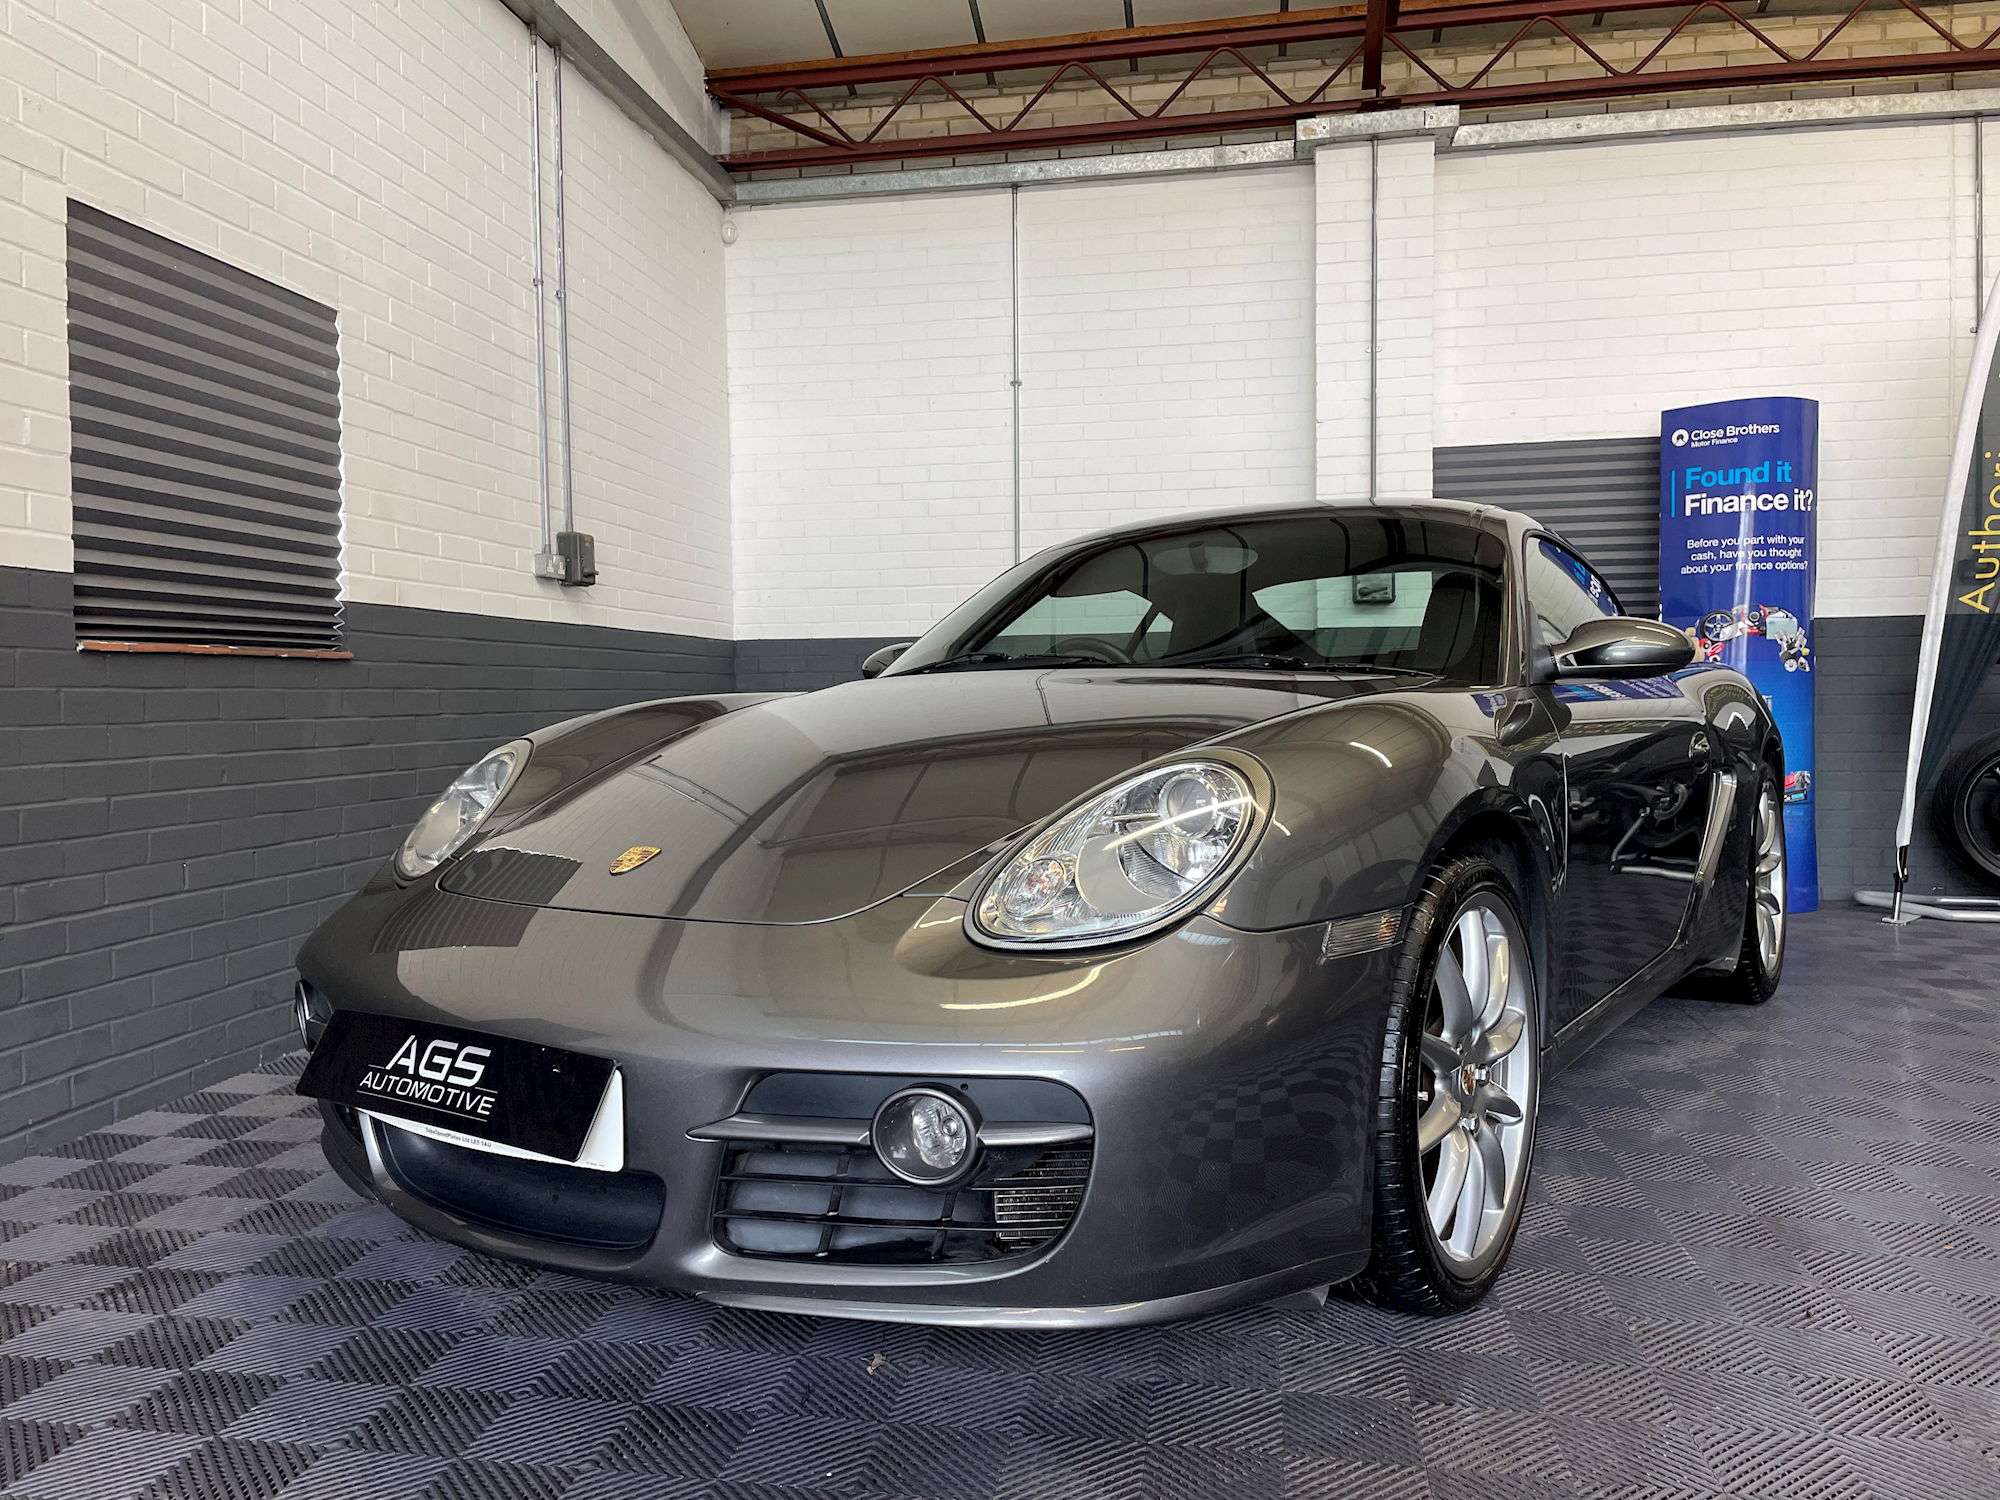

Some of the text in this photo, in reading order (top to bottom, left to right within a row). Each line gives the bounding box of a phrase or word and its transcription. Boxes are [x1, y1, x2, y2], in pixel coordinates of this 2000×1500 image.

[1691, 423, 1780, 441] Close Brothers
[1691, 437, 1738, 448] Motor Finance
[1685, 460, 1792, 490] Found it
[1684, 488, 1813, 517] Finance it?
[1687, 535, 1805, 549] Before you part with your
[1690, 547, 1802, 561] cash, have you thought
[1680, 560, 1808, 575] about your finance options?
[385, 1034, 492, 1088] AGS
[359, 1071, 496, 1116] AUTOMOTIVE
